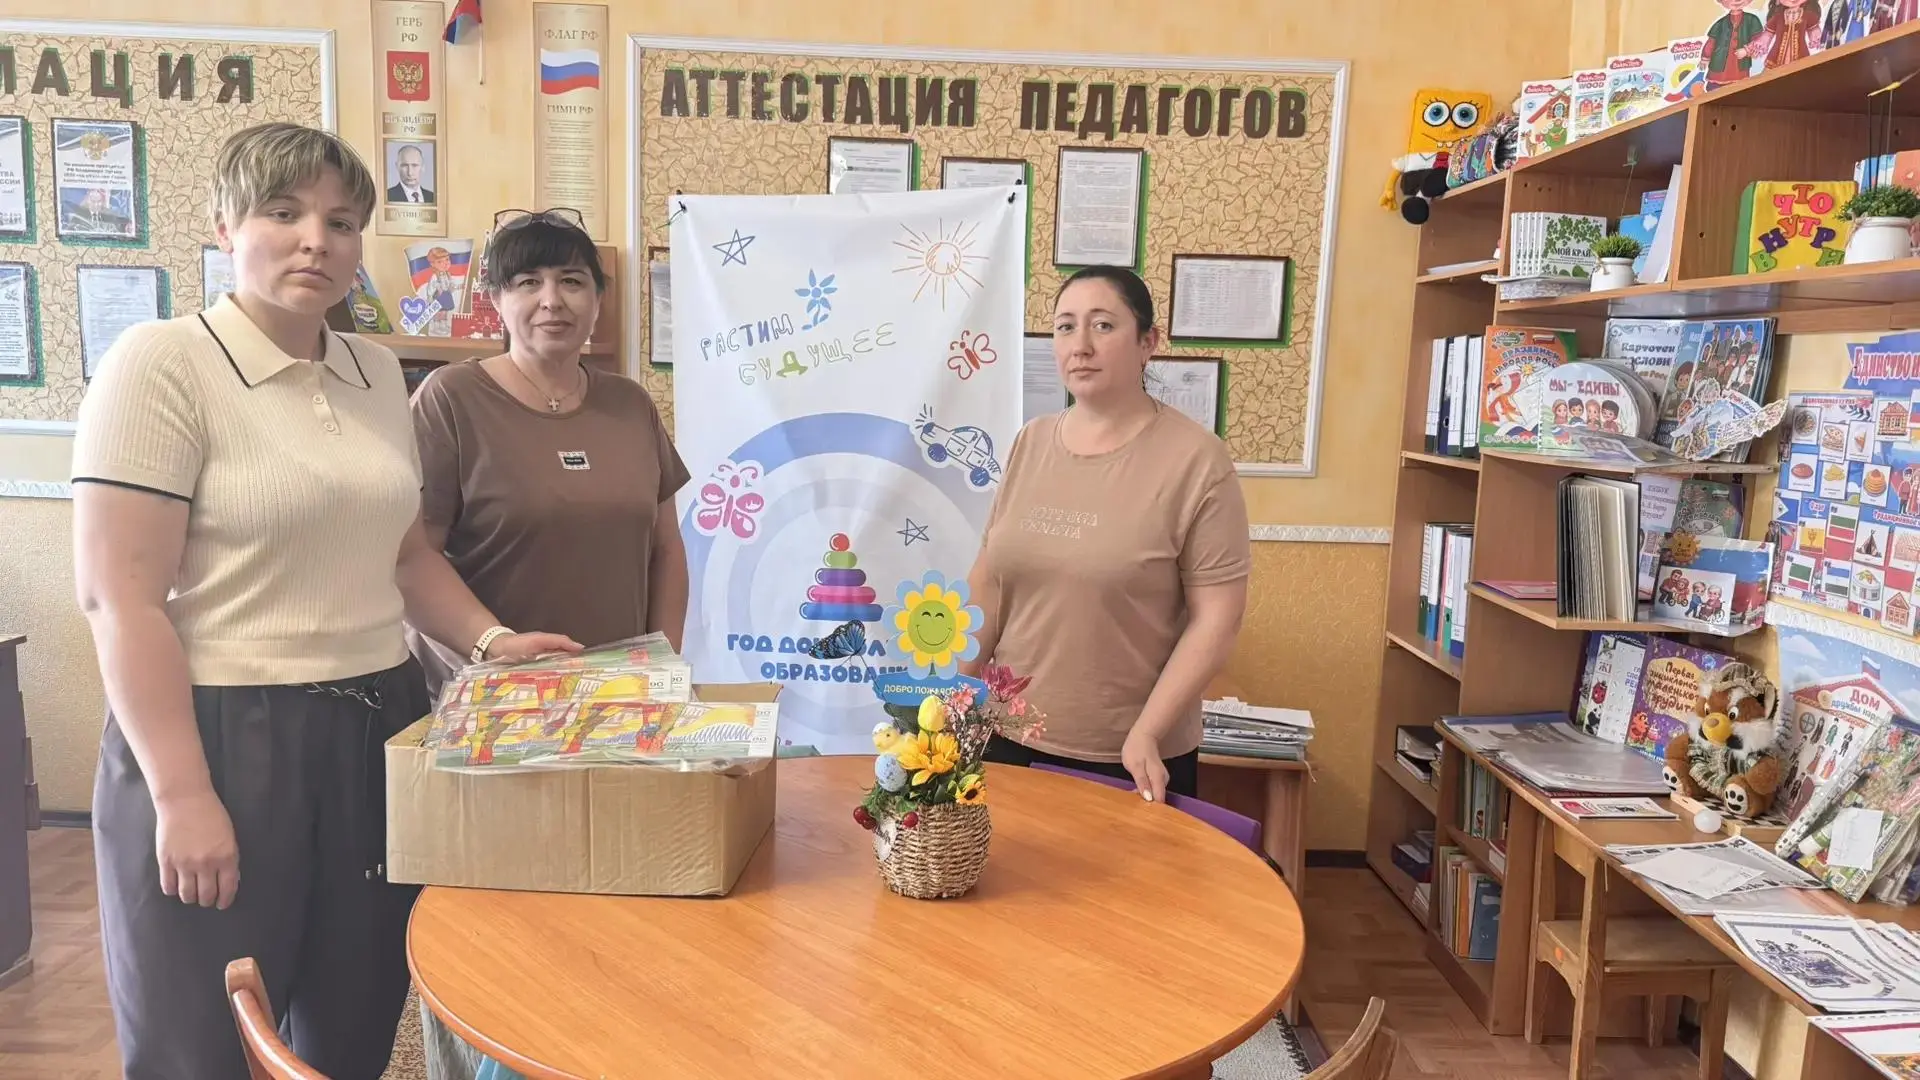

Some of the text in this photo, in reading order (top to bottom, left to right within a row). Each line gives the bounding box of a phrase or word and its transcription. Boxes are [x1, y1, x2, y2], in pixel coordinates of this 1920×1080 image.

[396, 16, 423, 27] ГЕРБ
[401, 32, 418, 42] РФ
[545, 29, 600, 40] ФЛАГ РФ
[547, 104, 594, 115] ГИМН РФ
[661, 68, 1307, 141] АТТЕСТАЦИЯ ПЕДАГОГОВ
[1773, 184, 1834, 215] ЧТО
[1554, 246, 1591, 258] МОЙ КРАЙ
[700, 313, 794, 361] РАСТИМ
[739, 322, 897, 385] БУДУЩЕЕ
[1622, 342, 1676, 353] Картотек
[1535, 355, 1559, 369] РОСС
[1577, 379, 1620, 397] ЕДИНЫ
[727, 633, 774, 653] ГОД
[760, 661, 908, 684] ОБРАЗОВА
[1666, 661, 1695, 680] Первая
[883, 684, 913, 694] ДОБРО
[1646, 679, 1700, 702] маленьког
[1831, 699, 1861, 713] дружбы
[1850, 689, 1880, 711] ДОМ
